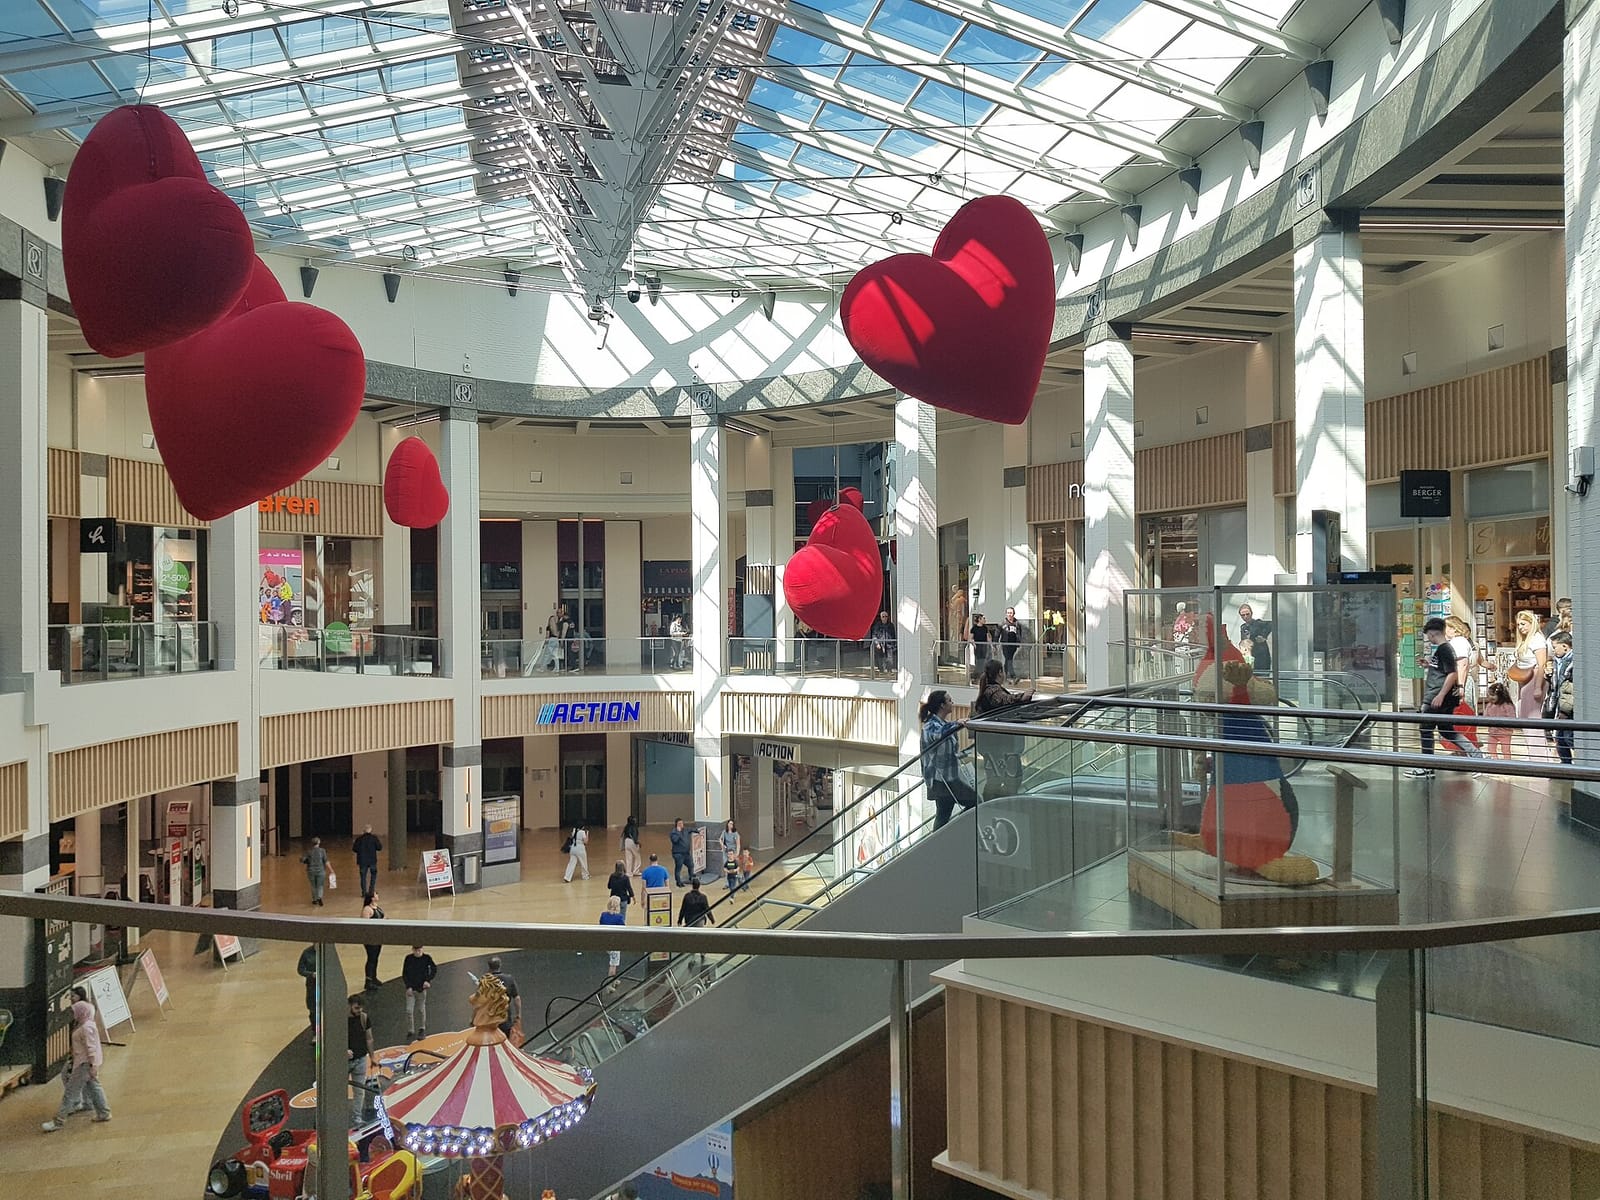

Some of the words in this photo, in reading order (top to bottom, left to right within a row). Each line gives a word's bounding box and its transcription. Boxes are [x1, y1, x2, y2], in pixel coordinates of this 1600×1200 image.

[258, 495, 320, 515] aren
[549, 701, 641, 724] ACTION
[759, 742, 795, 761] ACTION
